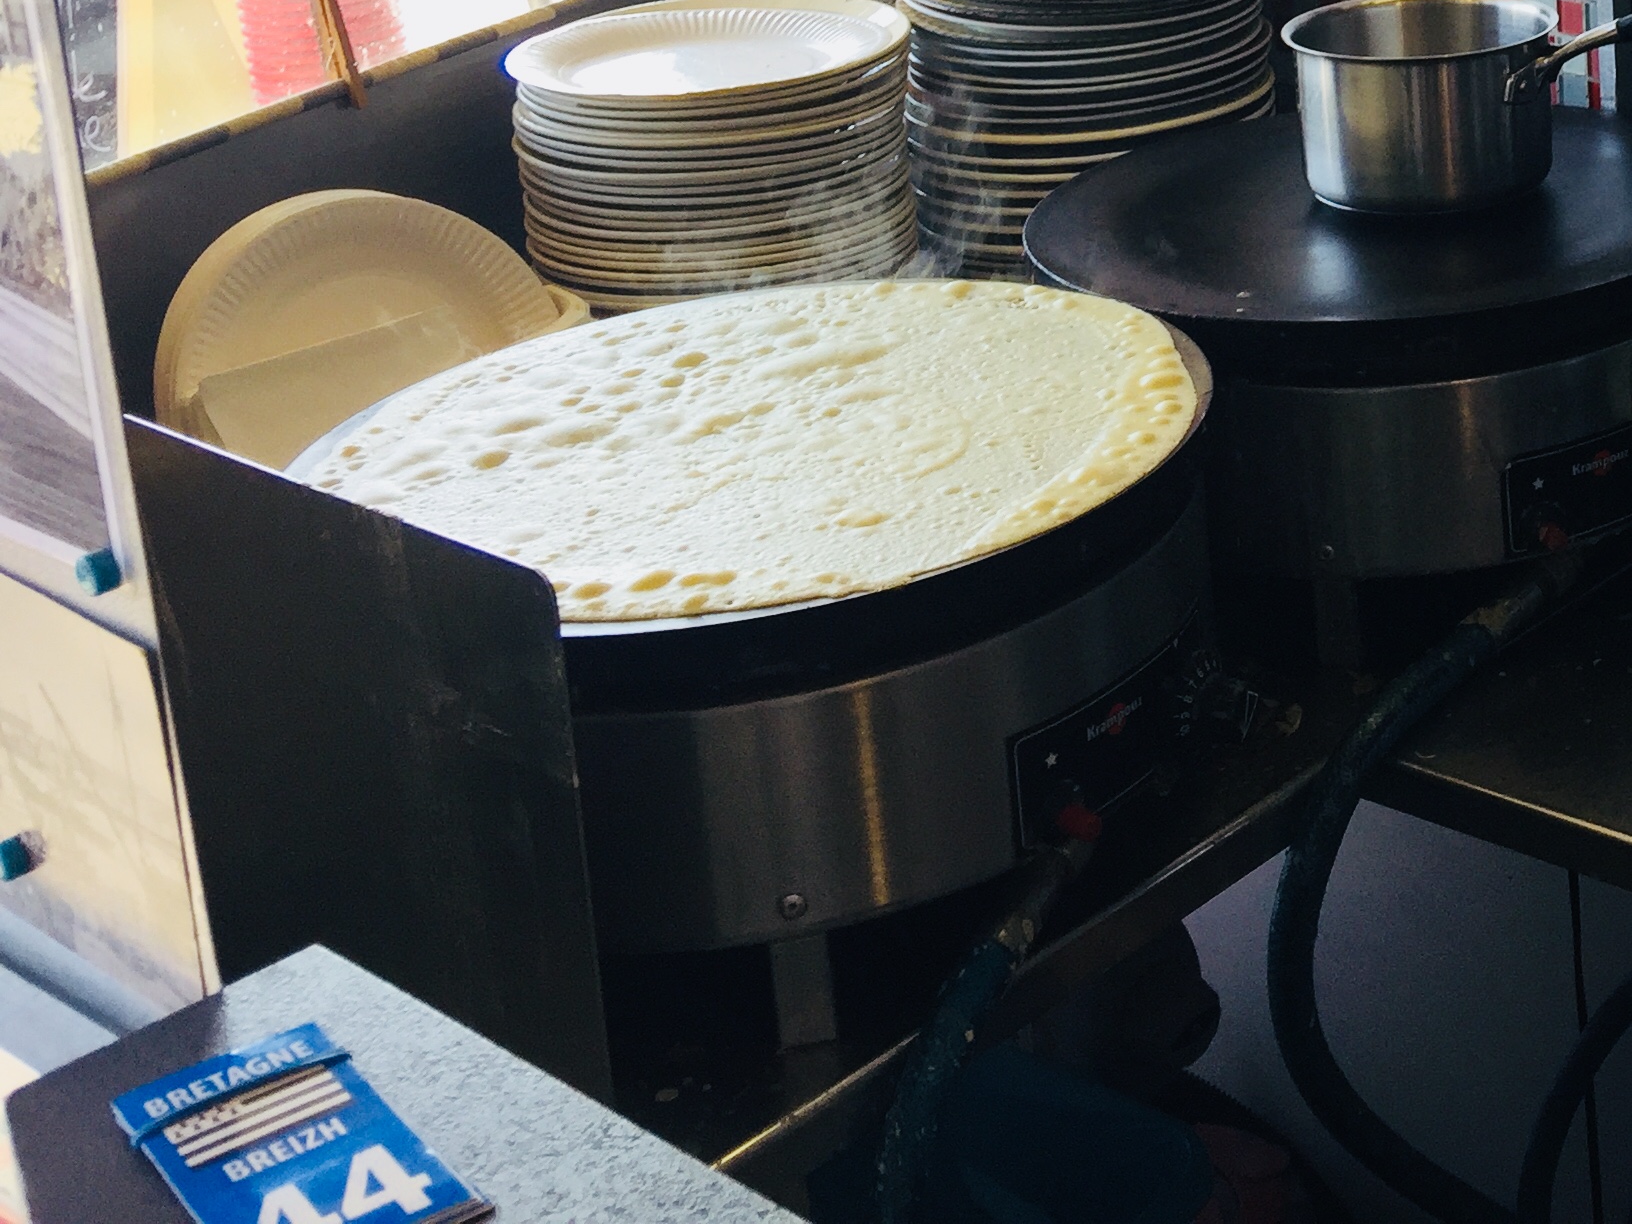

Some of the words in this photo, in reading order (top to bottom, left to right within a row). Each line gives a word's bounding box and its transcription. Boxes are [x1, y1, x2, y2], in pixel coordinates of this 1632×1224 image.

[143, 1039, 315, 1120] BRETAGNE
[222, 1116, 349, 1183] BREIZH
[256, 1142, 435, 1224] 44
